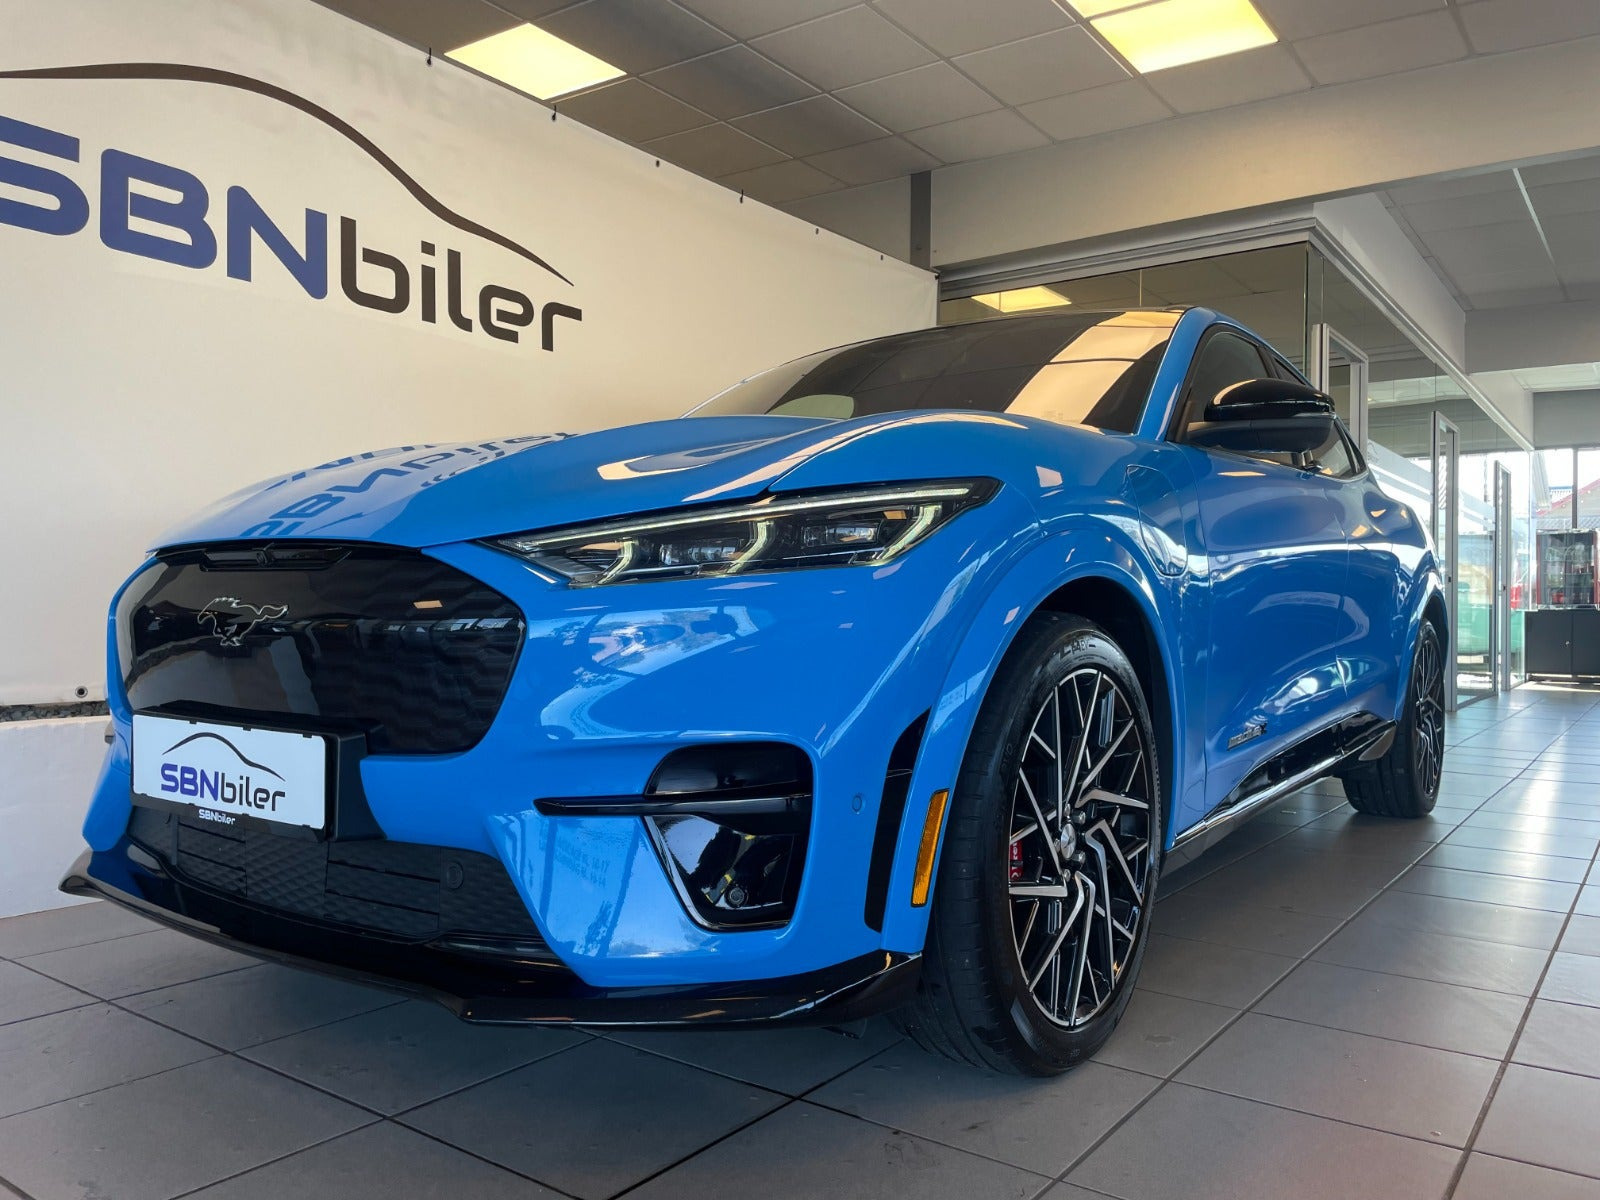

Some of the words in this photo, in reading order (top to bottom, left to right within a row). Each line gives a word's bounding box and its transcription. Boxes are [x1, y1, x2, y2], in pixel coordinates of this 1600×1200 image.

[0, 115, 582, 352] SBNbiler
[161, 763, 286, 811] SBNbiler
[198, 808, 236, 825] SBNbiler
